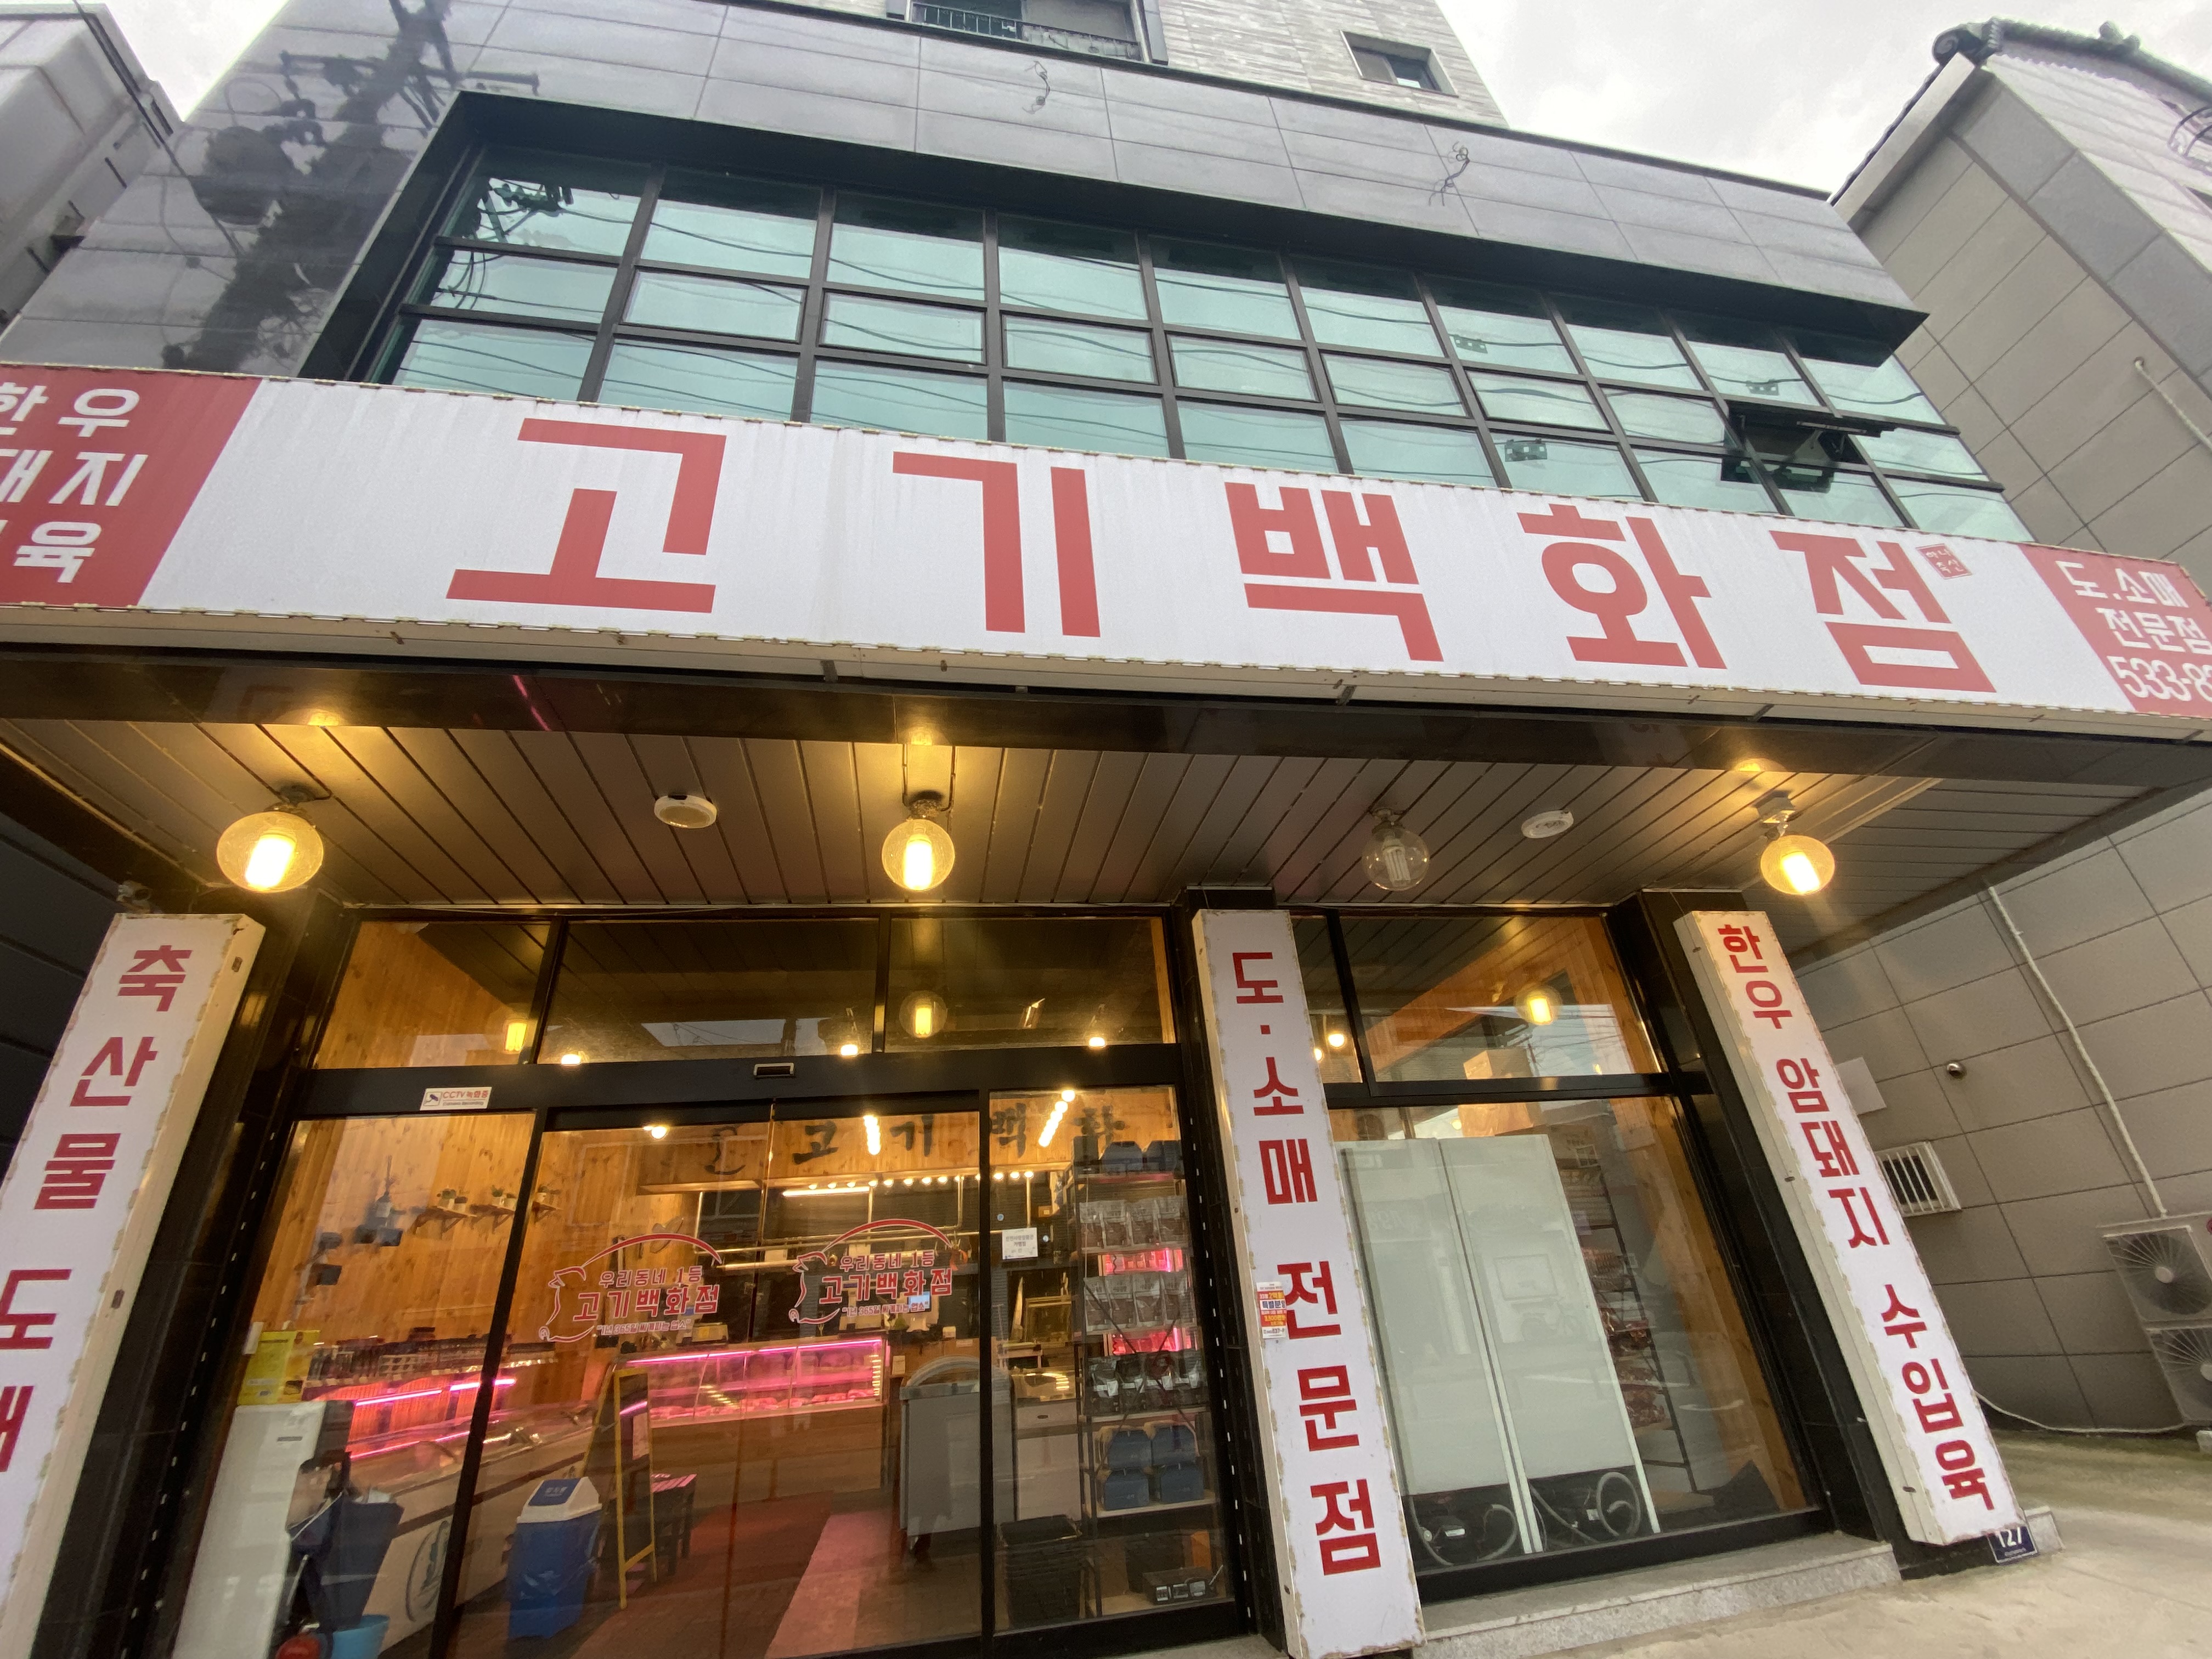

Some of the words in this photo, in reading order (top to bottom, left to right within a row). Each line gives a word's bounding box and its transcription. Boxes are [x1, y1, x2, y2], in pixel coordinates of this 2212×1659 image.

[0, 382, 139, 437] 한우
[0, 520, 102, 583] 육
[446, 418, 1997, 693] 고기백화점
[2095, 607, 2212, 655] 전문점
[34, 945, 193, 1210] 축산물
[443, 1091, 466, 1099] CCTV
[1718, 924, 1792, 1029] 한우
[1776, 1058, 1890, 1248] 암돼지
[1880, 1284, 1995, 1511] 수입육
[599, 1268, 667, 1289] 우리동네
[676, 1265, 703, 1284] 1등
[819, 1267, 953, 1304] 고기백화점
[839, 1252, 902, 1272] 우리동네
[911, 1249, 935, 1268] 1등
[572, 1284, 720, 1322] 고기백화점
[1277, 1261, 1381, 1576] 전문점
